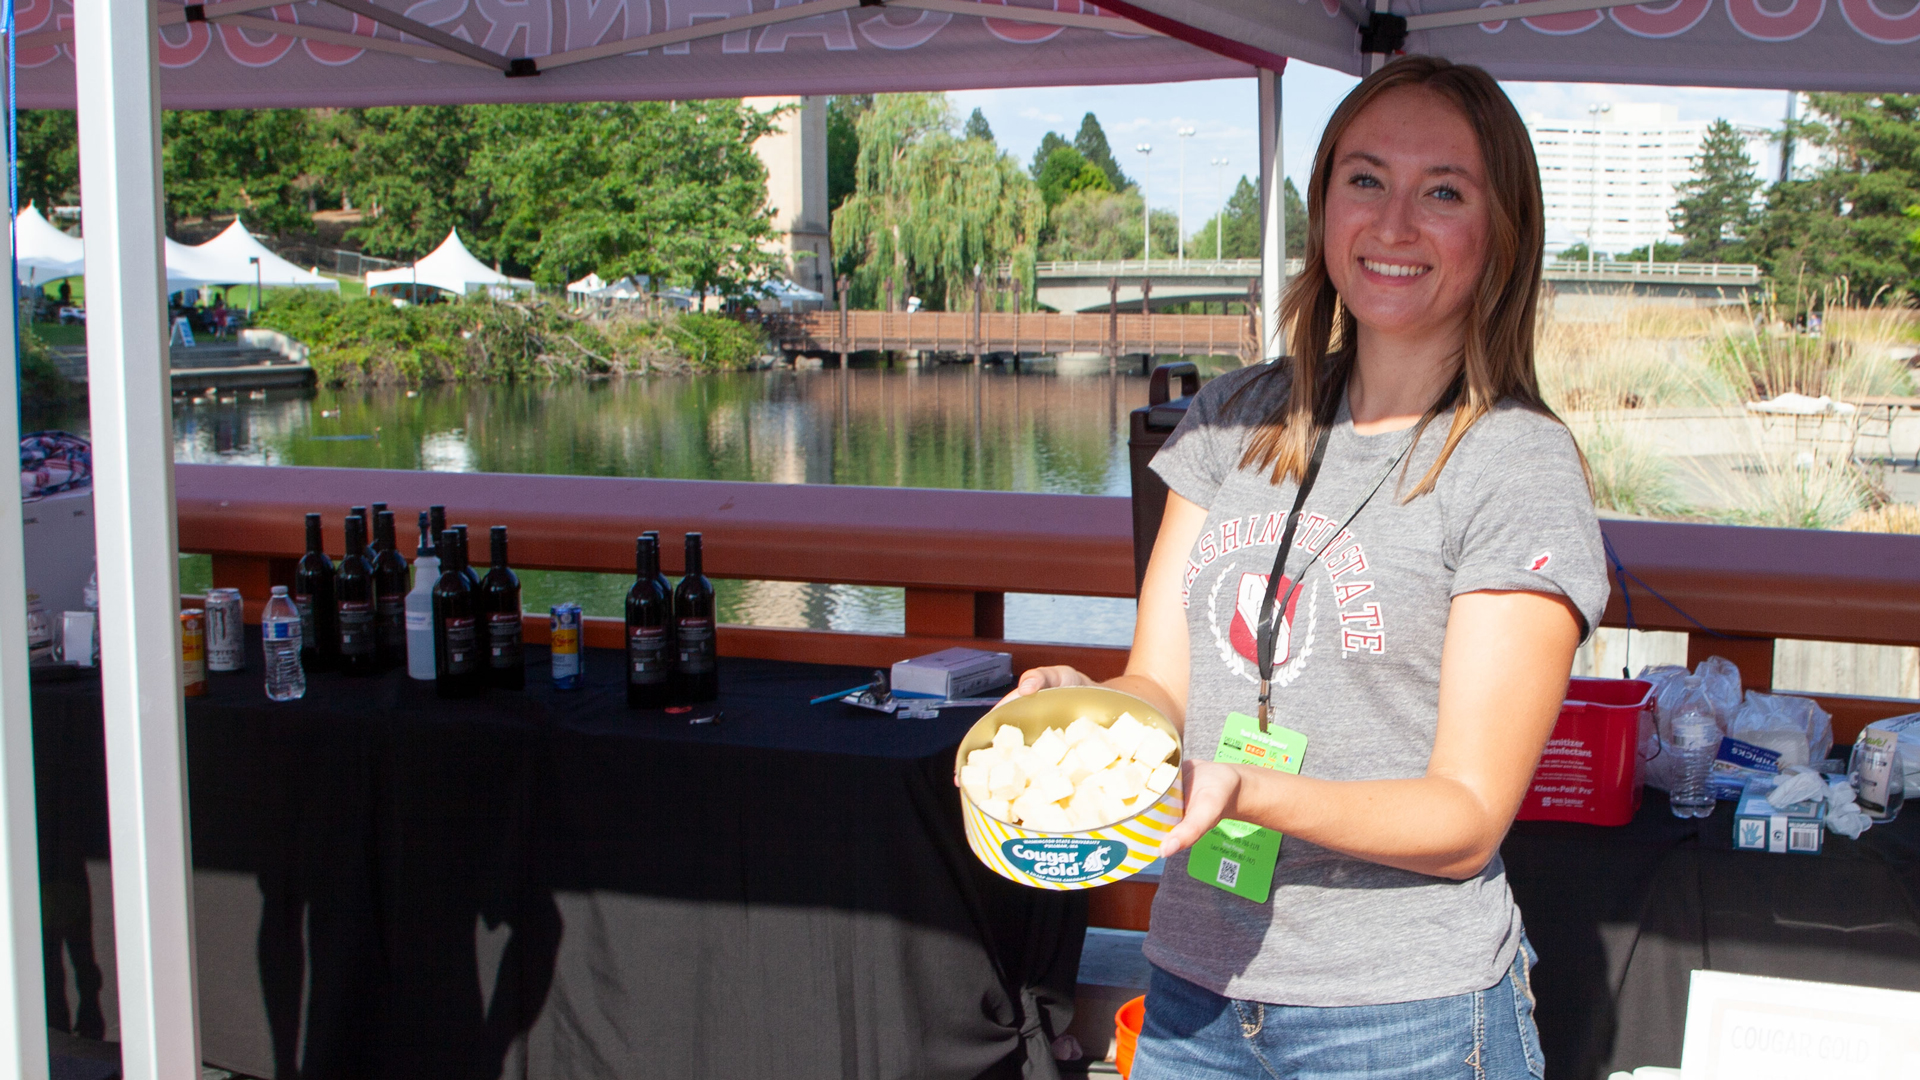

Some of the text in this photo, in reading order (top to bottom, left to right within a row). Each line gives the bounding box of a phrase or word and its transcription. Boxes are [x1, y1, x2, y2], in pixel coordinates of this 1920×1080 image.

[1182, 509, 1355, 609] ASHINTON
[1325, 542, 1386, 655] STATE
[1012, 844, 1079, 866] Cougar
[1034, 862, 1079, 876] Gold
[1731, 1025, 1869, 1064] COUGAR GOLD
